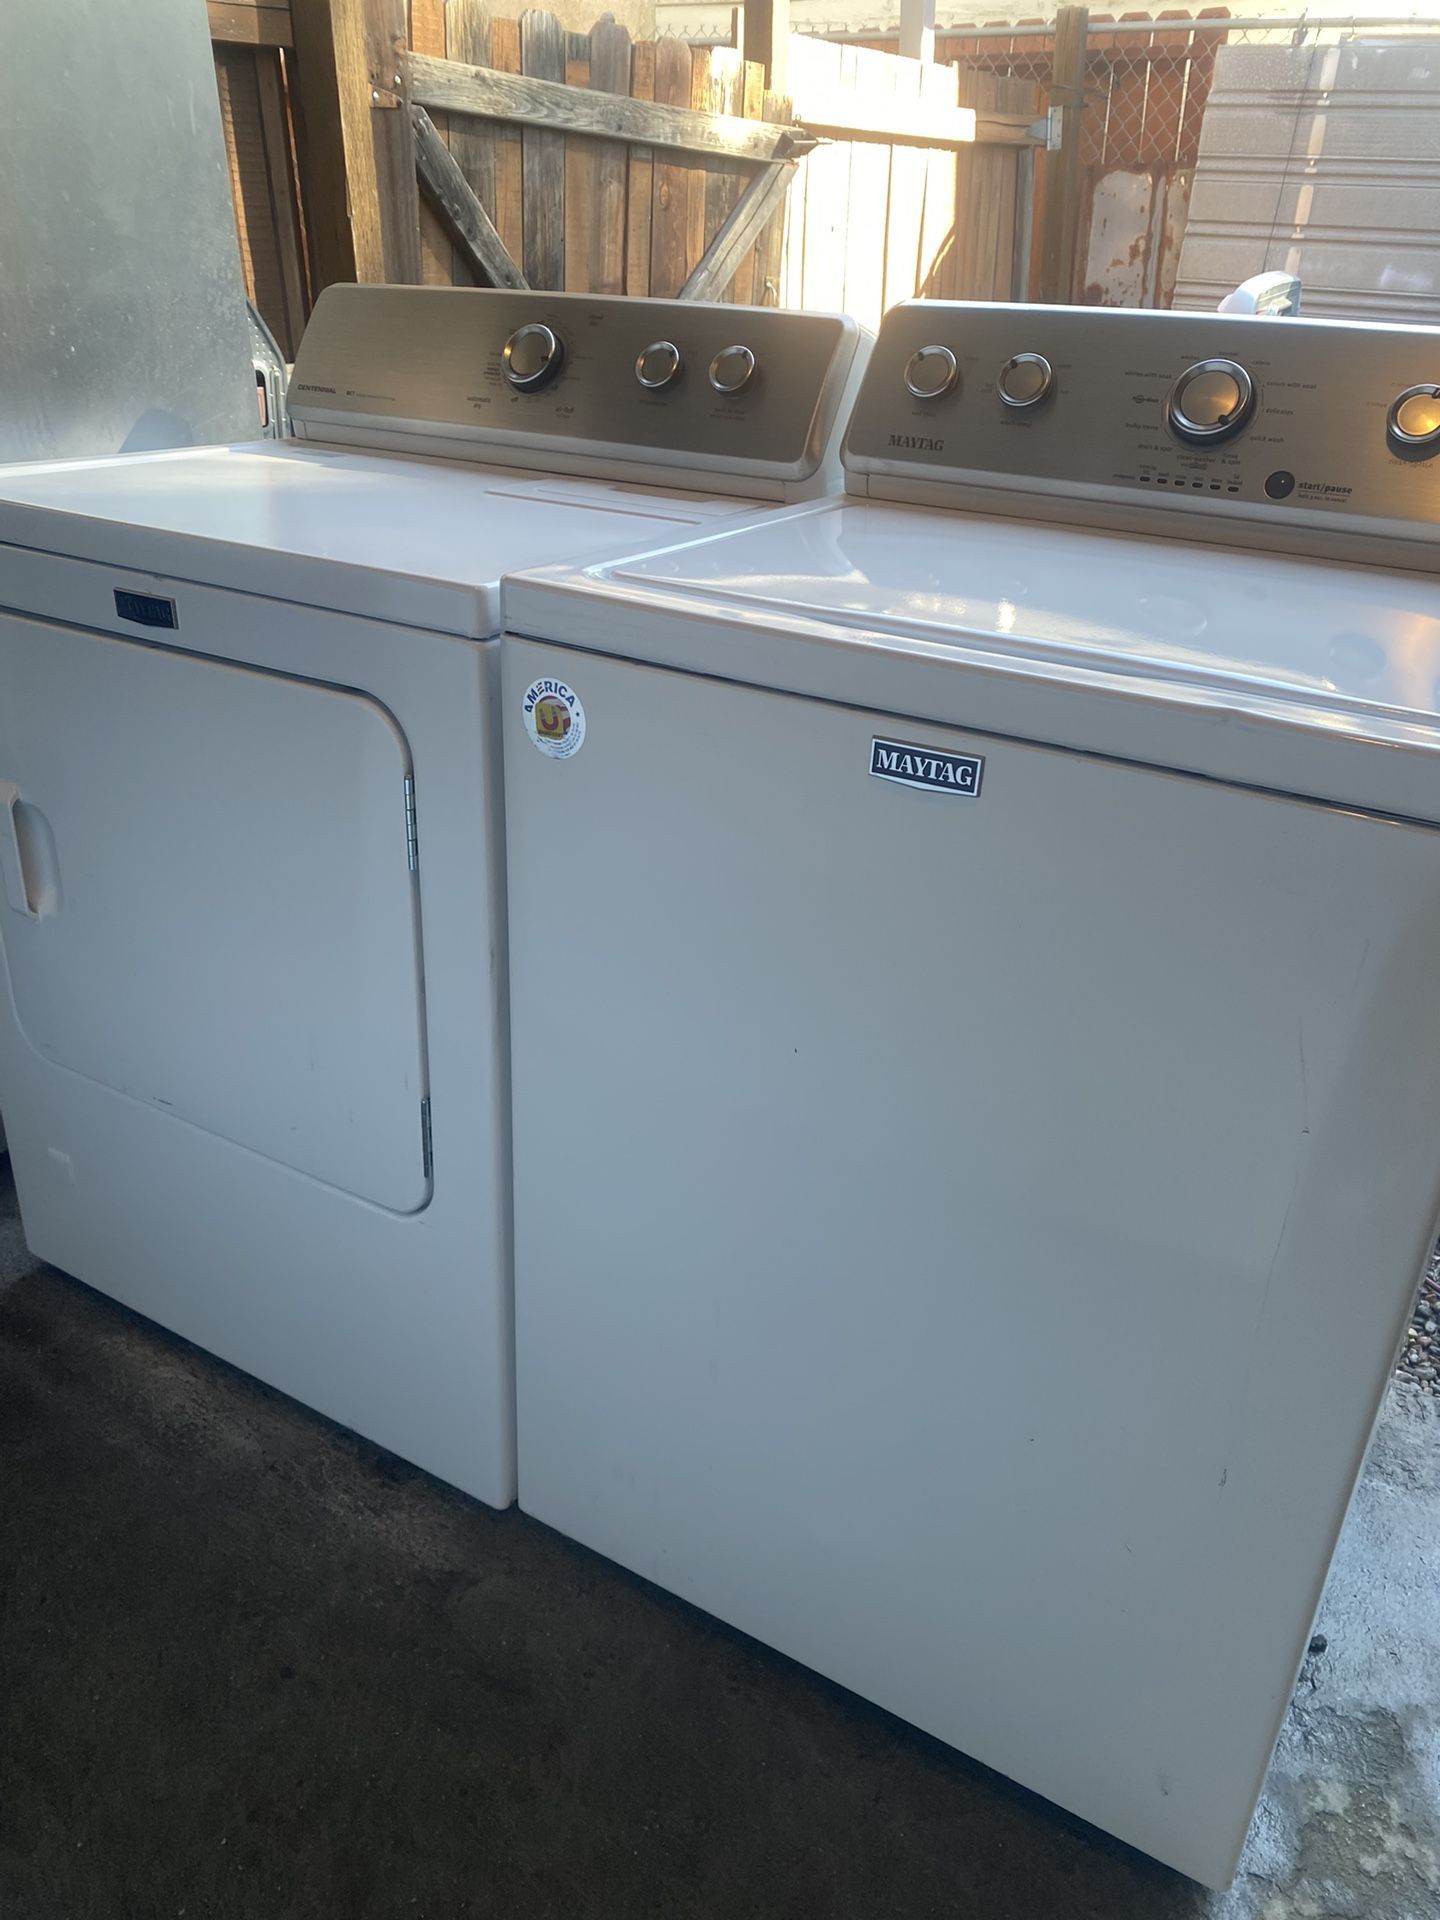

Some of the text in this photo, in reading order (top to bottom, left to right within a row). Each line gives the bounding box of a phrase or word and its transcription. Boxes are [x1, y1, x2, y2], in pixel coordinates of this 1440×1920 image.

[297, 384, 336, 394] CENTENNIAL
[888, 435, 945, 452] MAYTAG
[1298, 482, 1353, 494] start/pause
[524, 681, 575, 712] AMERICA
[876, 748, 973, 786] MAYTAG
